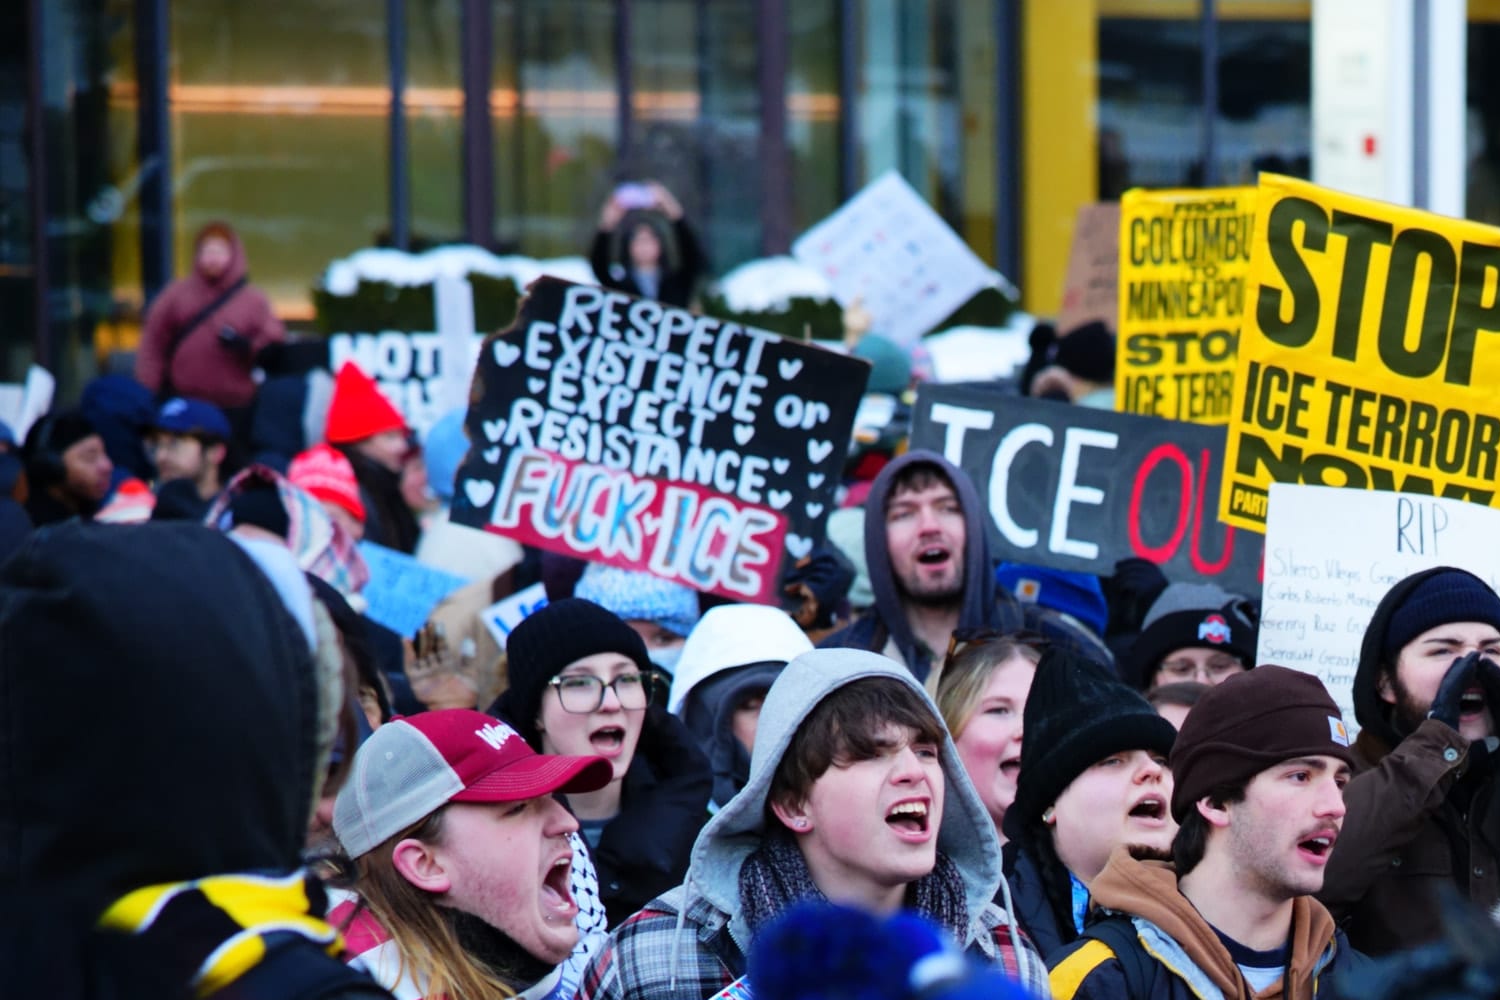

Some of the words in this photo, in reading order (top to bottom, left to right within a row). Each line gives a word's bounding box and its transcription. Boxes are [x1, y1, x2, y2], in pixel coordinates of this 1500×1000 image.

[1174, 199, 1237, 213] FROM
[1130, 214, 1255, 267] COLUMBU
[1190, 262, 1218, 279] TO
[1128, 277, 1245, 321] MINNEAPO
[560, 286, 782, 376] RESPECT
[1126, 328, 1240, 368] STO
[524, 321, 768, 423] EXISTENCE
[1124, 373, 1164, 417] ICE
[1173, 370, 1235, 418] TERR
[1242, 360, 1313, 440] ICE
[549, 366, 718, 446] EXPECT
[503, 397, 771, 504] RESISTANCE
[491, 444, 657, 562] FUCK
[648, 486, 778, 596] ICE
[930, 403, 1119, 560] ICE
[1127, 443, 1266, 584] OU
[1233, 489, 1269, 516] PART
[1395, 496, 1450, 557] RIP
